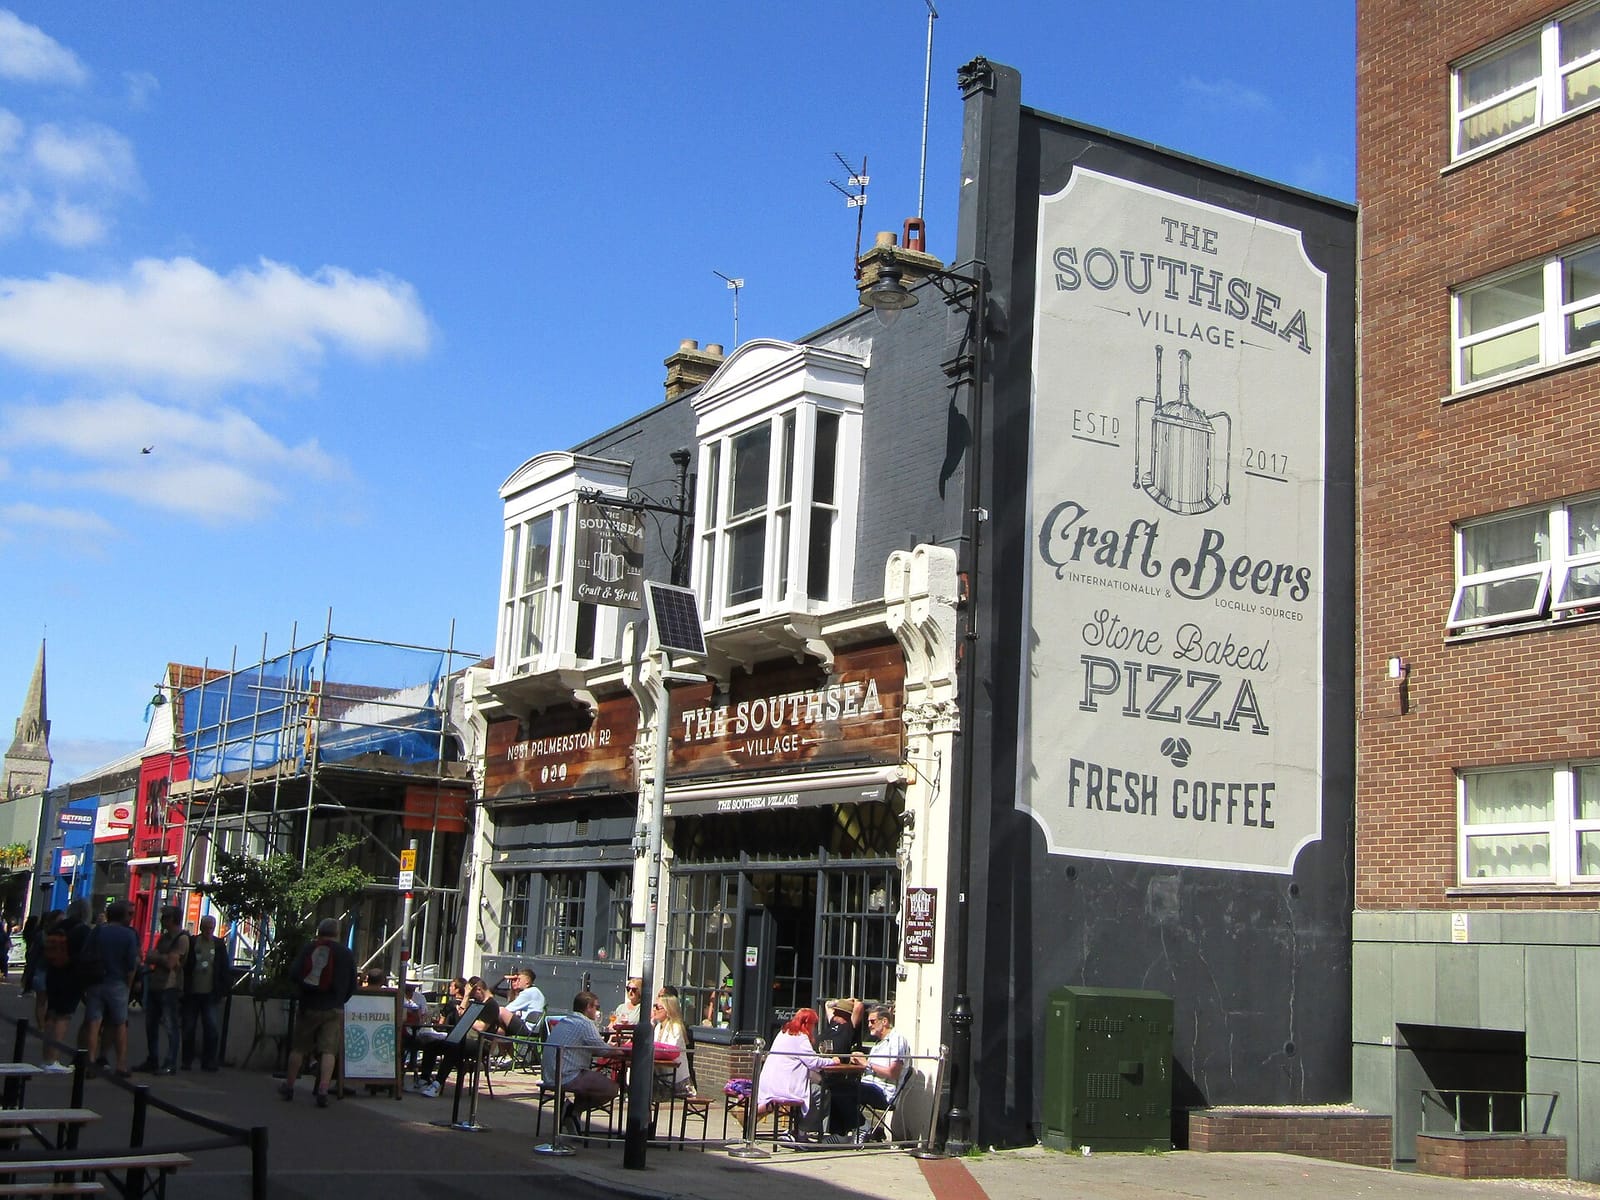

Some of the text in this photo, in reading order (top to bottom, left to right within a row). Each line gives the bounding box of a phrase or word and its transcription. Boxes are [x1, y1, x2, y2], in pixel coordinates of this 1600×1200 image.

[1161, 216, 1219, 255] THE
[1053, 246, 1312, 355] SOUTHSEA
[1137, 307, 1235, 349] VILLAGE
[1245, 447, 1289, 475] 2017
[579, 518, 644, 538] SOUTHSEA
[606, 511, 620, 520] THE
[1038, 500, 1312, 602] Craft Beers
[578, 583, 639, 602] Craft & Grill
[1068, 571, 1304, 622] INTERNATIONALLY & LOCALLY SOURCED
[1082, 608, 1270, 672] Stone Baked
[682, 678, 883, 742] THE SOUTHSEA
[1079, 654, 1270, 736] PIZZA
[531, 730, 596, 757] PALMERSTON
[747, 734, 799, 757] VILLAGE
[717, 794, 799, 811] THE SOUTHSEA VILLAGE
[1067, 757, 1276, 829] FRESH COFFEE
